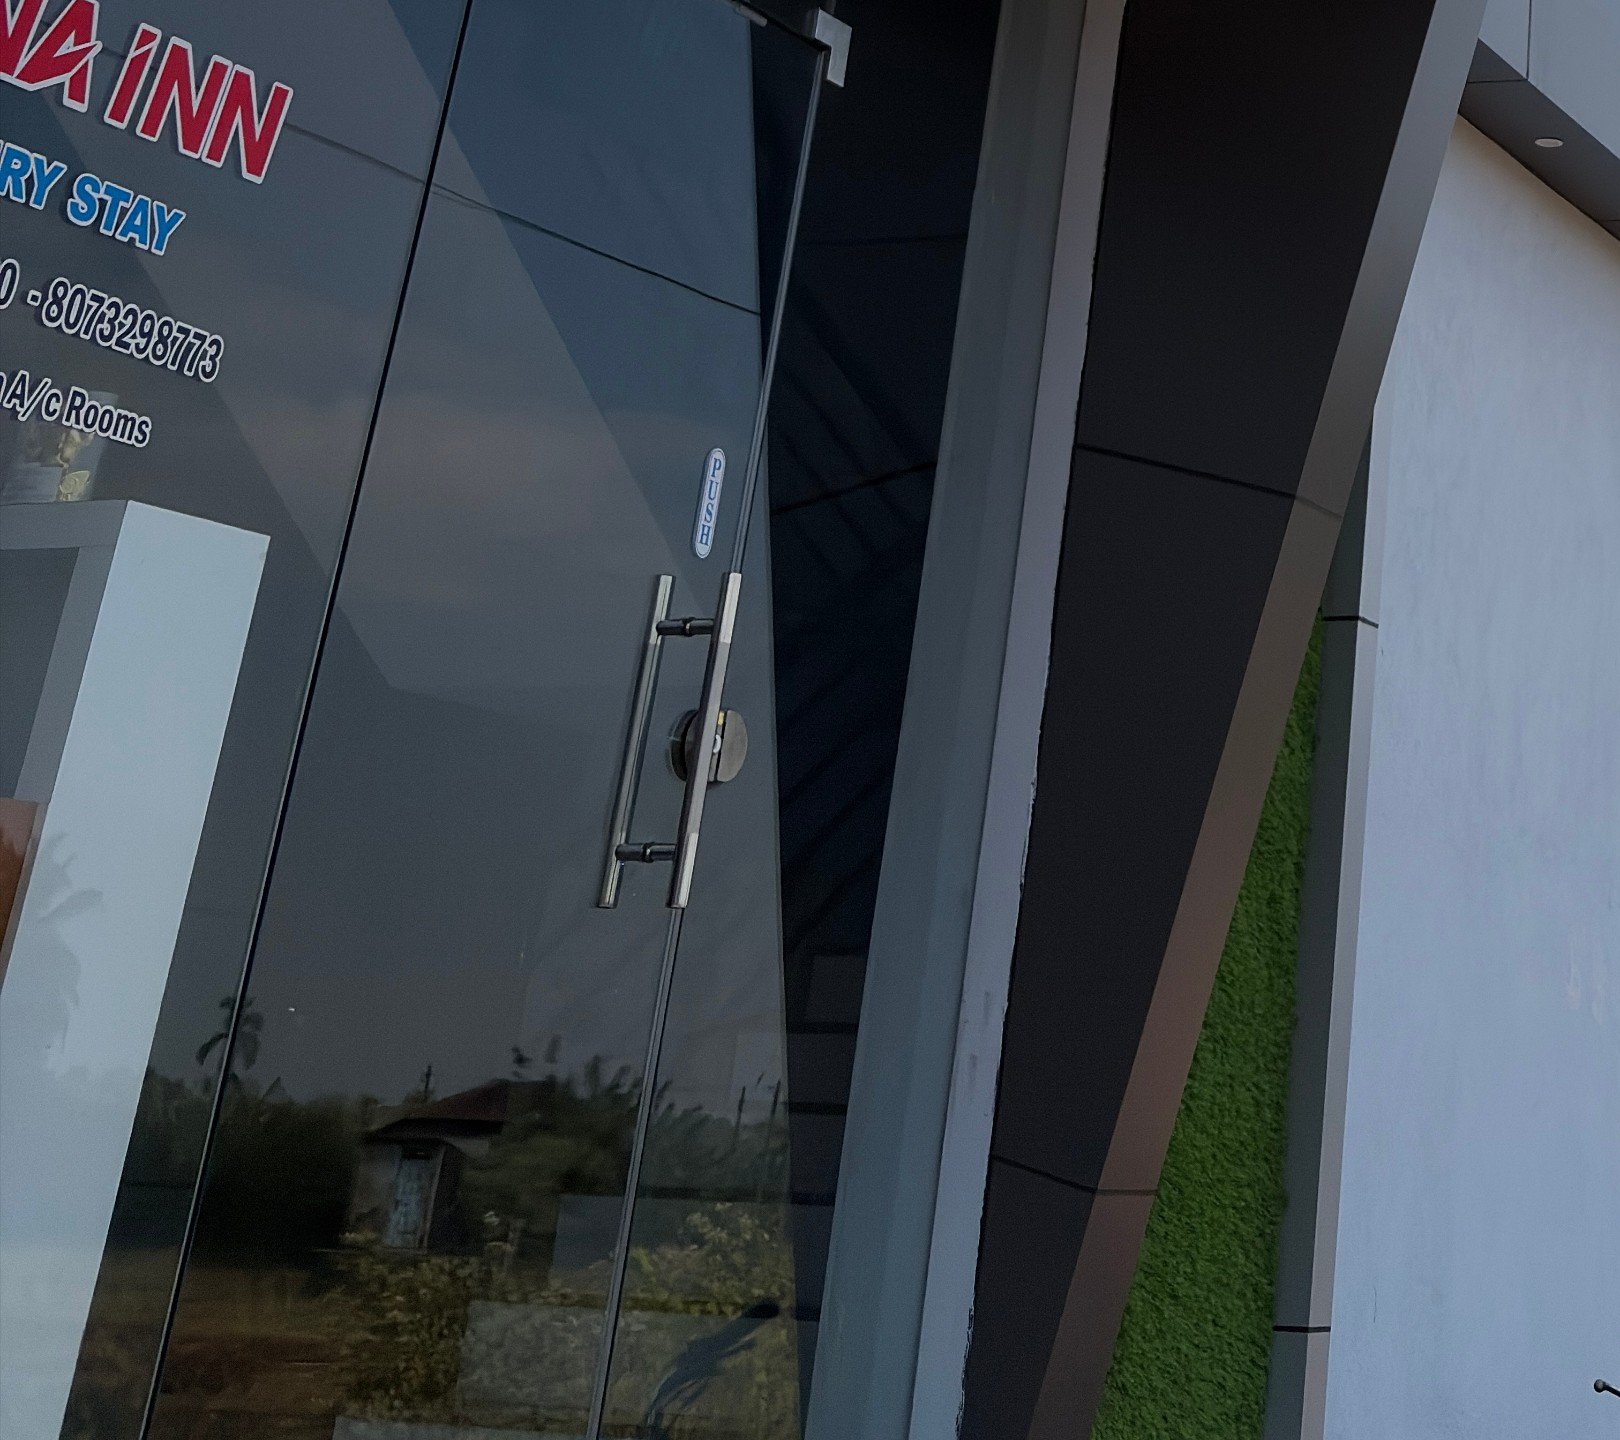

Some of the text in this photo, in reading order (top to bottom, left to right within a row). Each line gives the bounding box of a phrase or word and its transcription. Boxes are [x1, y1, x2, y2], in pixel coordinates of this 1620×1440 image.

[103, 22, 294, 184] INN
[0, 140, 186, 256] RY STAY
[42, 277, 224, 383] 8073298773
[62, 386, 152, 448] Rooms
[700, 457, 722, 546] PUSH
